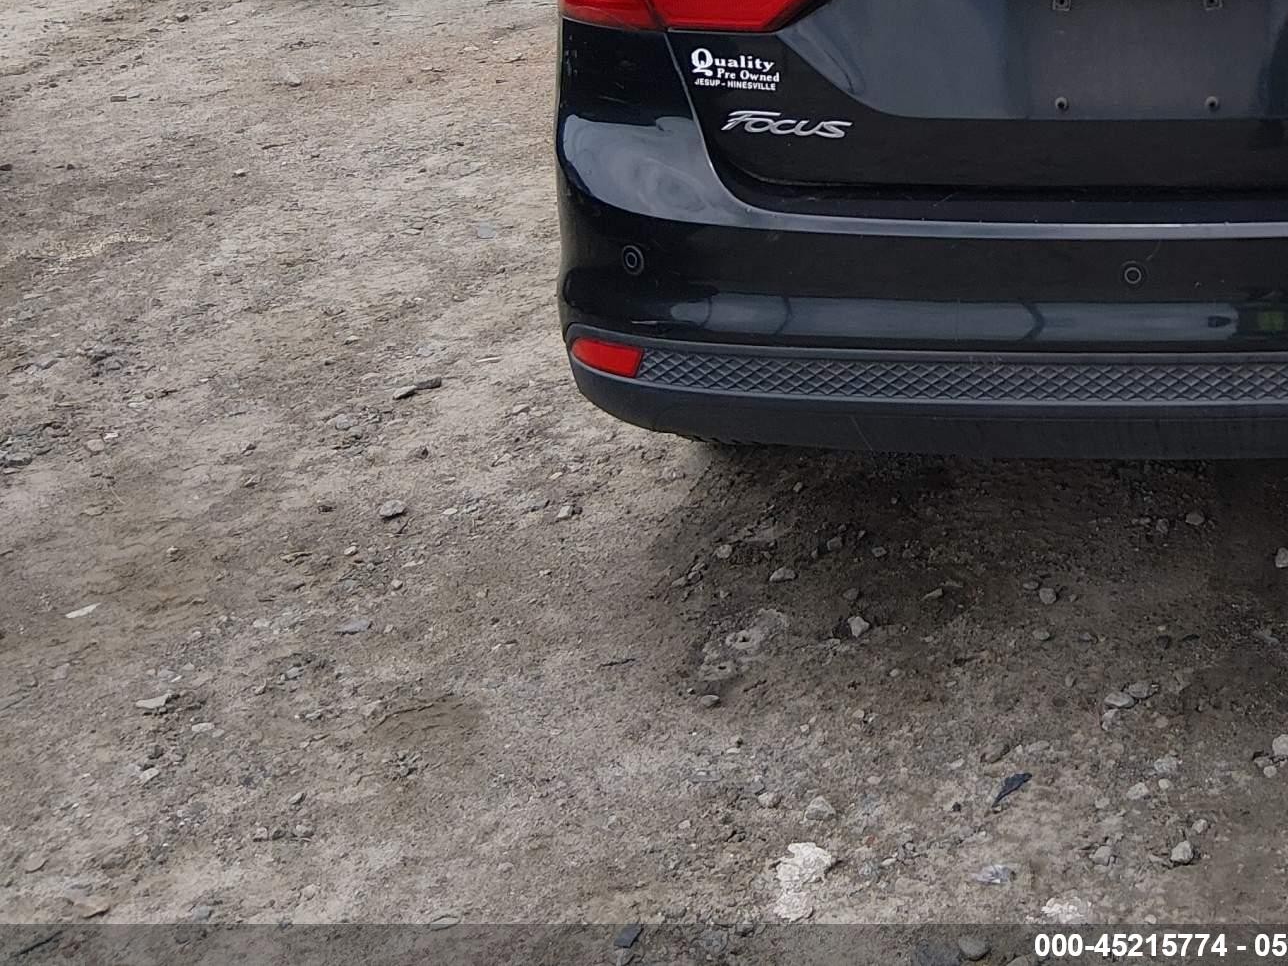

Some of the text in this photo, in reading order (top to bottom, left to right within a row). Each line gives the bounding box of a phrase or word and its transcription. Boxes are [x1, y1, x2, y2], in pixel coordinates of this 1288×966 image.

[691, 48, 775, 77] Quality
[716, 68, 780, 83] Pre Owned
